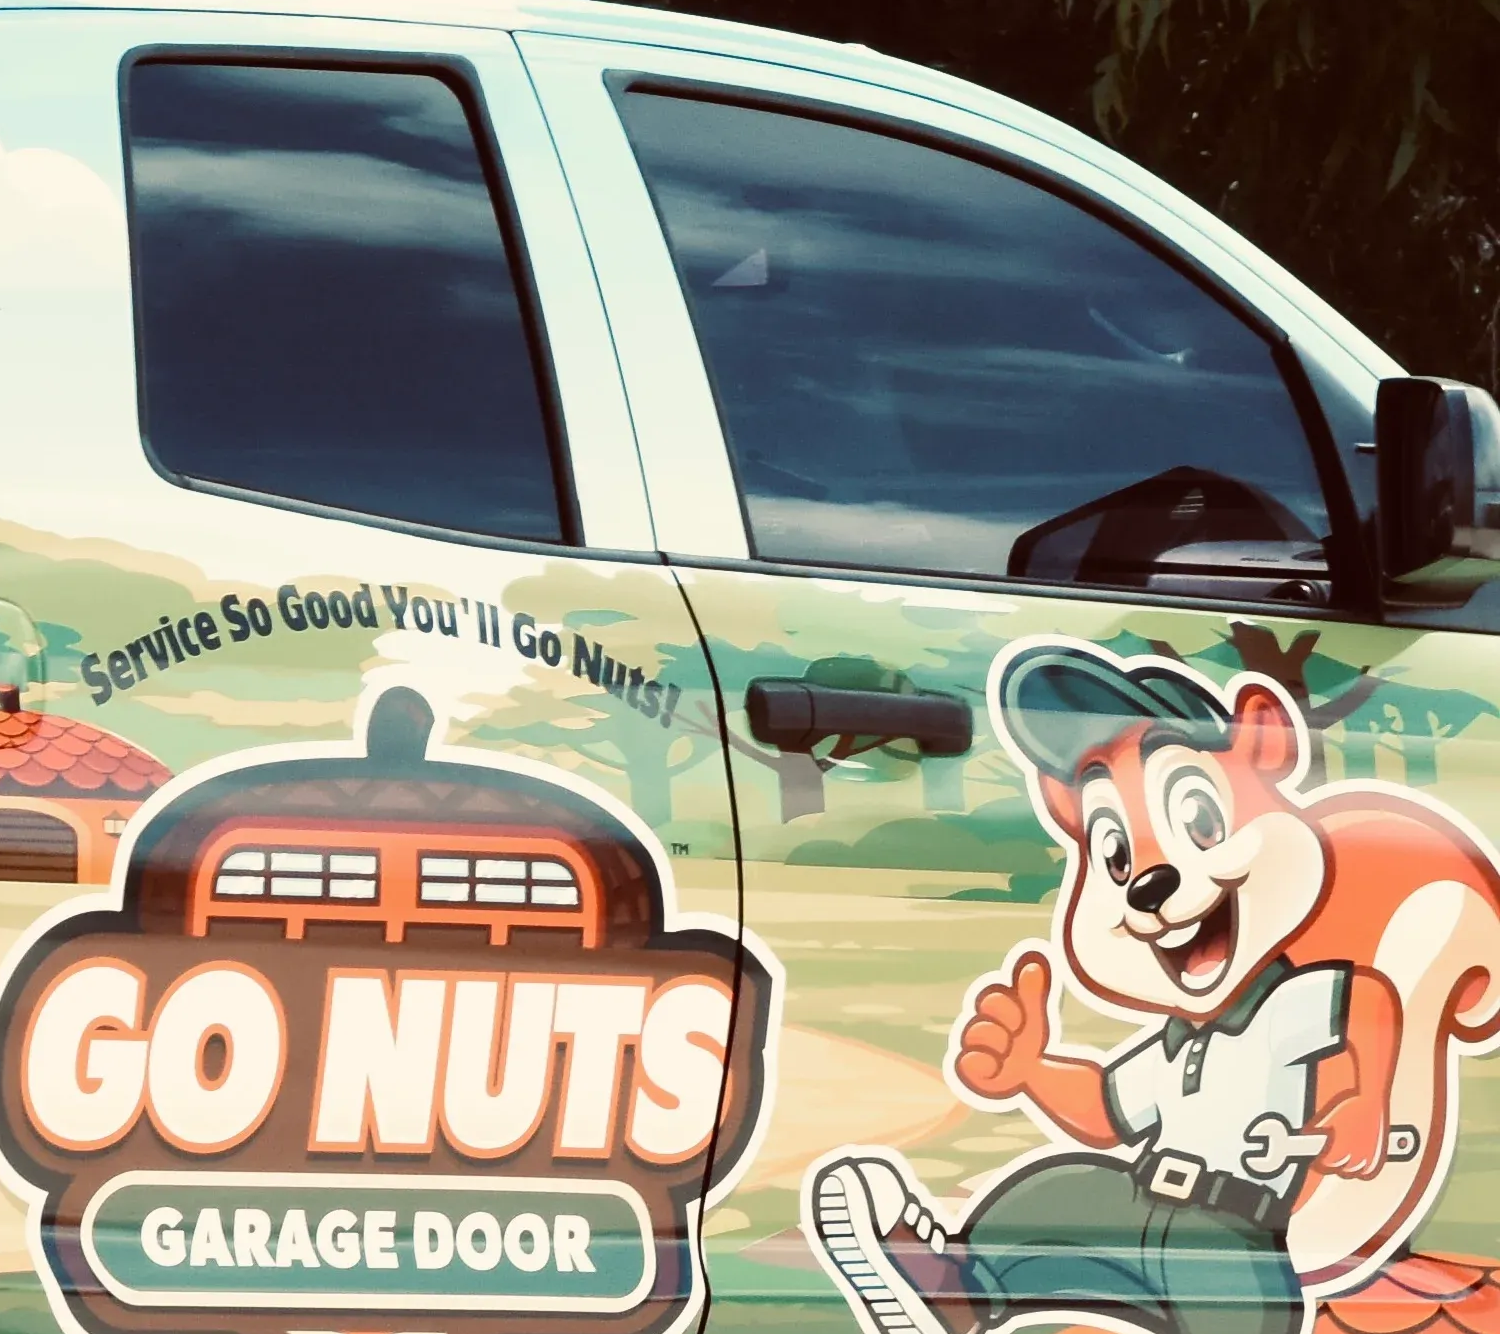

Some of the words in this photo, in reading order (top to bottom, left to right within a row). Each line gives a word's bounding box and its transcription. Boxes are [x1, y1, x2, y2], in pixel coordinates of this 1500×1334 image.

[80, 614, 220, 706] Service
[221, 593, 273, 643] So
[278, 583, 378, 631] Good
[380, 585, 501, 648] You'll
[512, 613, 562, 667] Go
[572, 633, 681, 728] Nuts!
[22, 956, 287, 1153] GO
[308, 967, 734, 1165] NUTS
[140, 1206, 400, 1269] GARAGE
[413, 1211, 597, 1273] DOOR
